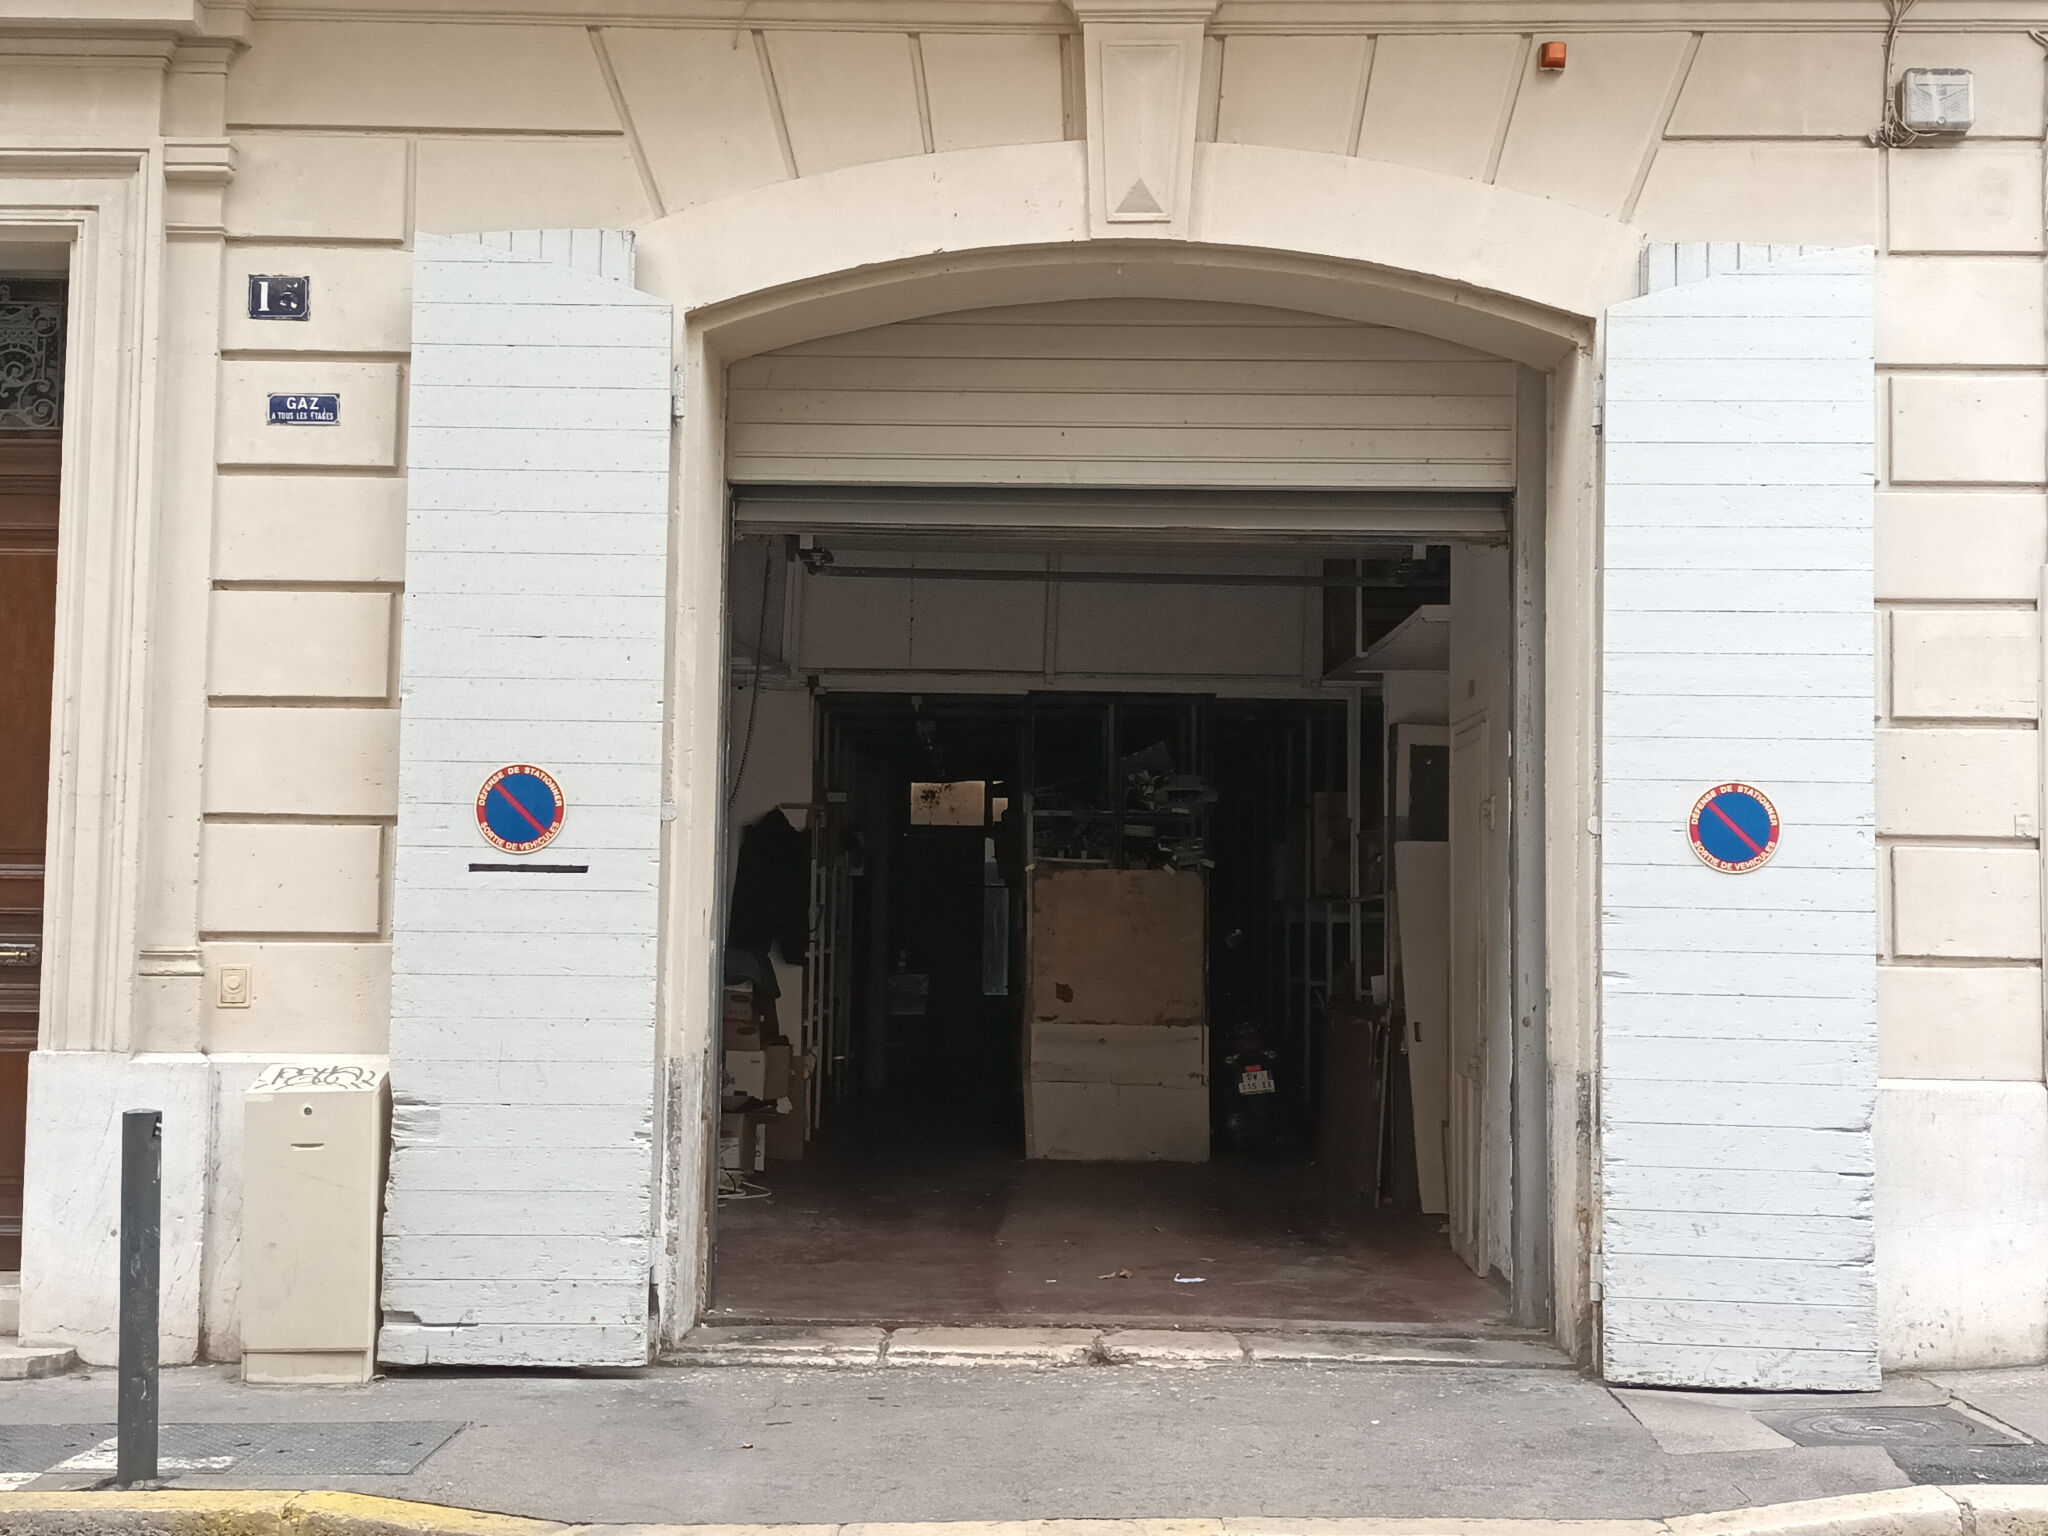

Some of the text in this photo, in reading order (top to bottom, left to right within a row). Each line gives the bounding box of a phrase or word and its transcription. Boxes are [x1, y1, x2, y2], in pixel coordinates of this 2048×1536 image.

[277, 412, 294, 420] TOUS
[296, 412, 308, 420] LES
[286, 397, 320, 410] GAZ
[478, 767, 563, 807] DEFENSE DE STATIONNER
[1691, 785, 1778, 827] DEFENSE DE STATIONNER
[480, 821, 560, 850] SORTIE DE VEHICULES
[1693, 840, 1776, 870] SORTIE DE VEHICULES
